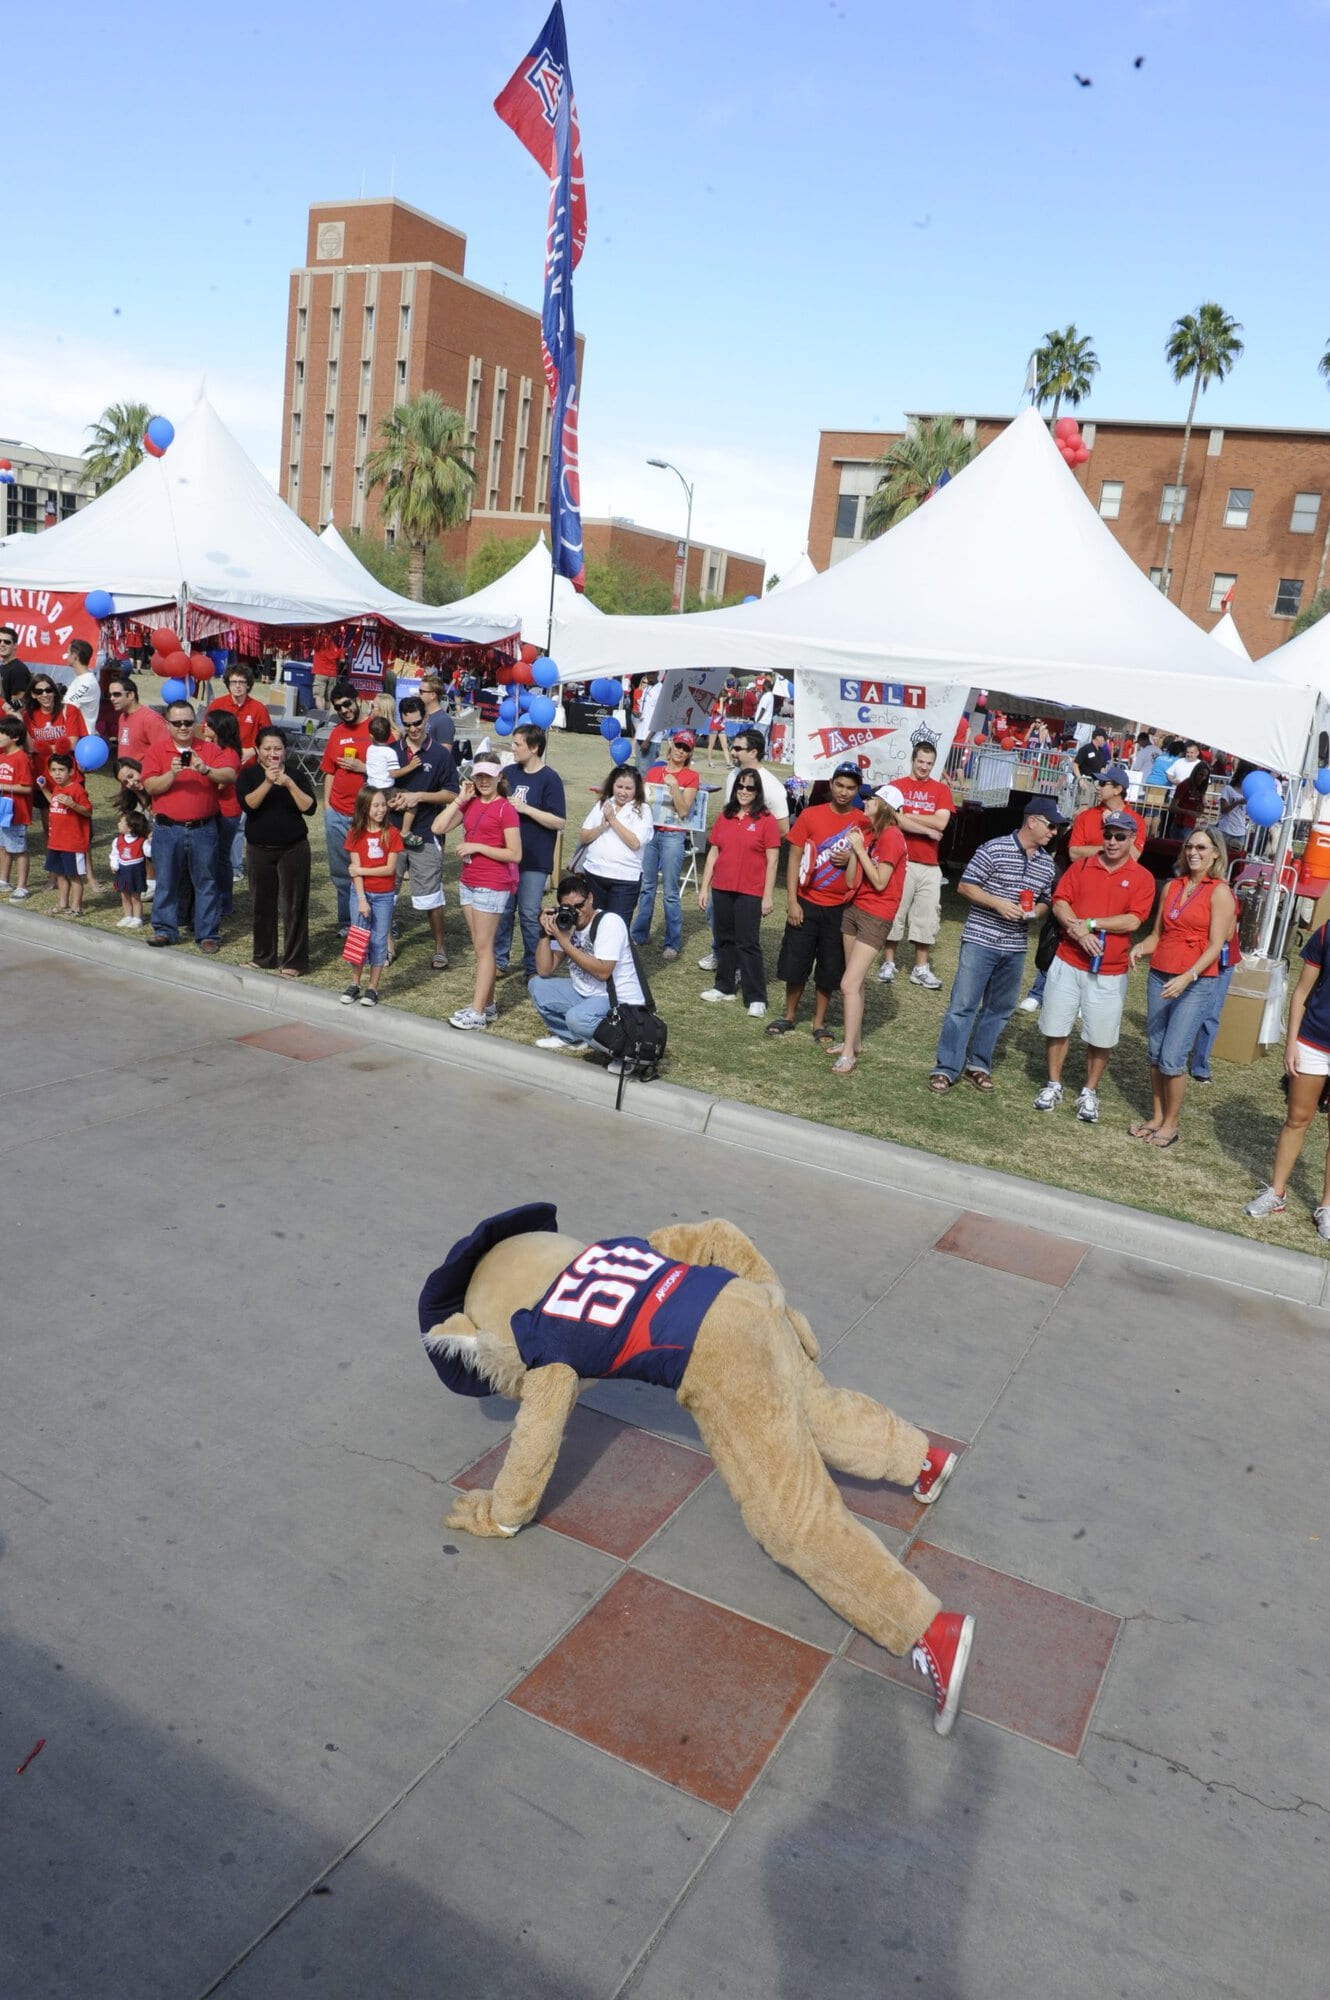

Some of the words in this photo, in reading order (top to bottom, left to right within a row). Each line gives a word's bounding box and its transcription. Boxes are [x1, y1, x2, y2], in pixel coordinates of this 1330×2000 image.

[351, 626, 384, 677] A
[844, 680, 922, 706] SALT
[857, 706, 908, 729] Center
[827, 728, 874, 754] Aged
[887, 737, 907, 760] to
[542, 1244, 667, 1328] 50
